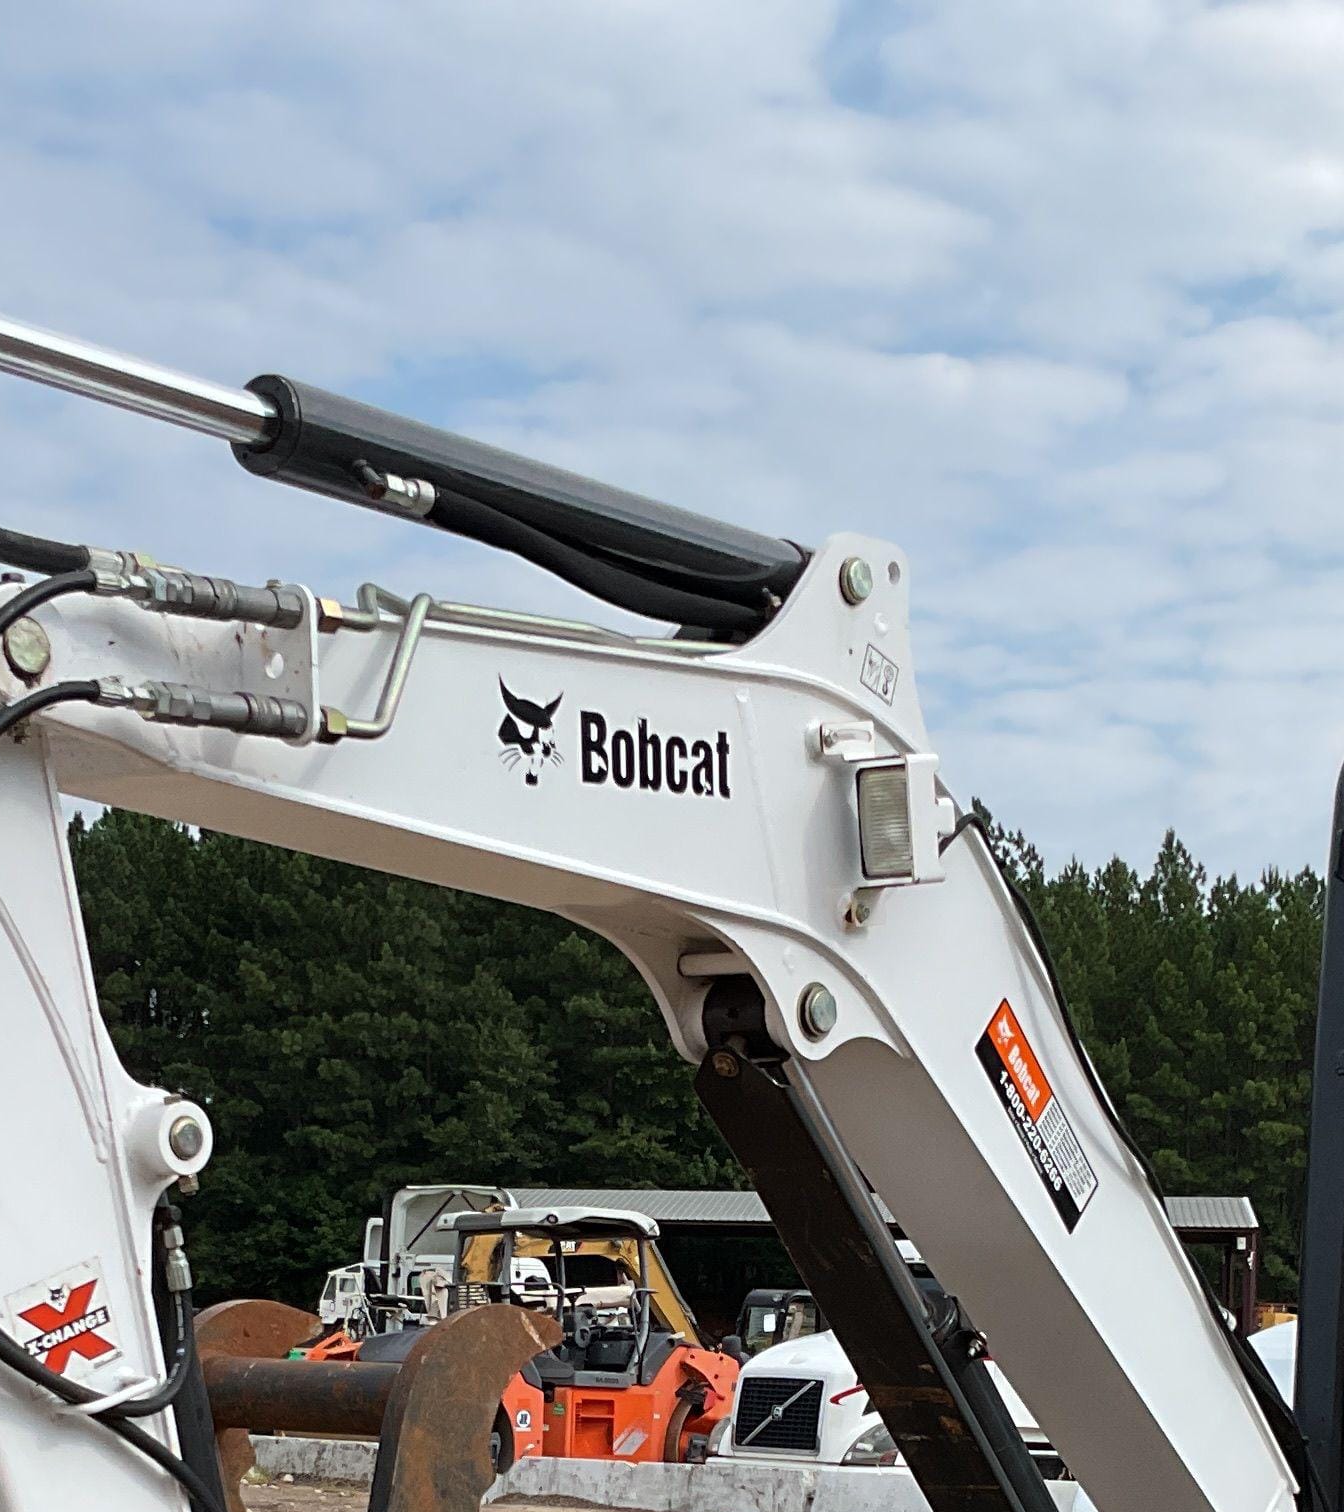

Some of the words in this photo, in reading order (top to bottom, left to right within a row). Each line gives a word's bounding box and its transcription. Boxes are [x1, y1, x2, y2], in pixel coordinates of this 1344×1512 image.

[580, 710, 731, 799] Bobcat
[1007, 1043, 1041, 1109] Bobcat
[999, 1069, 1062, 1192] 1-800-220-6266
[26, 1309, 107, 1356] X-CHANGE
